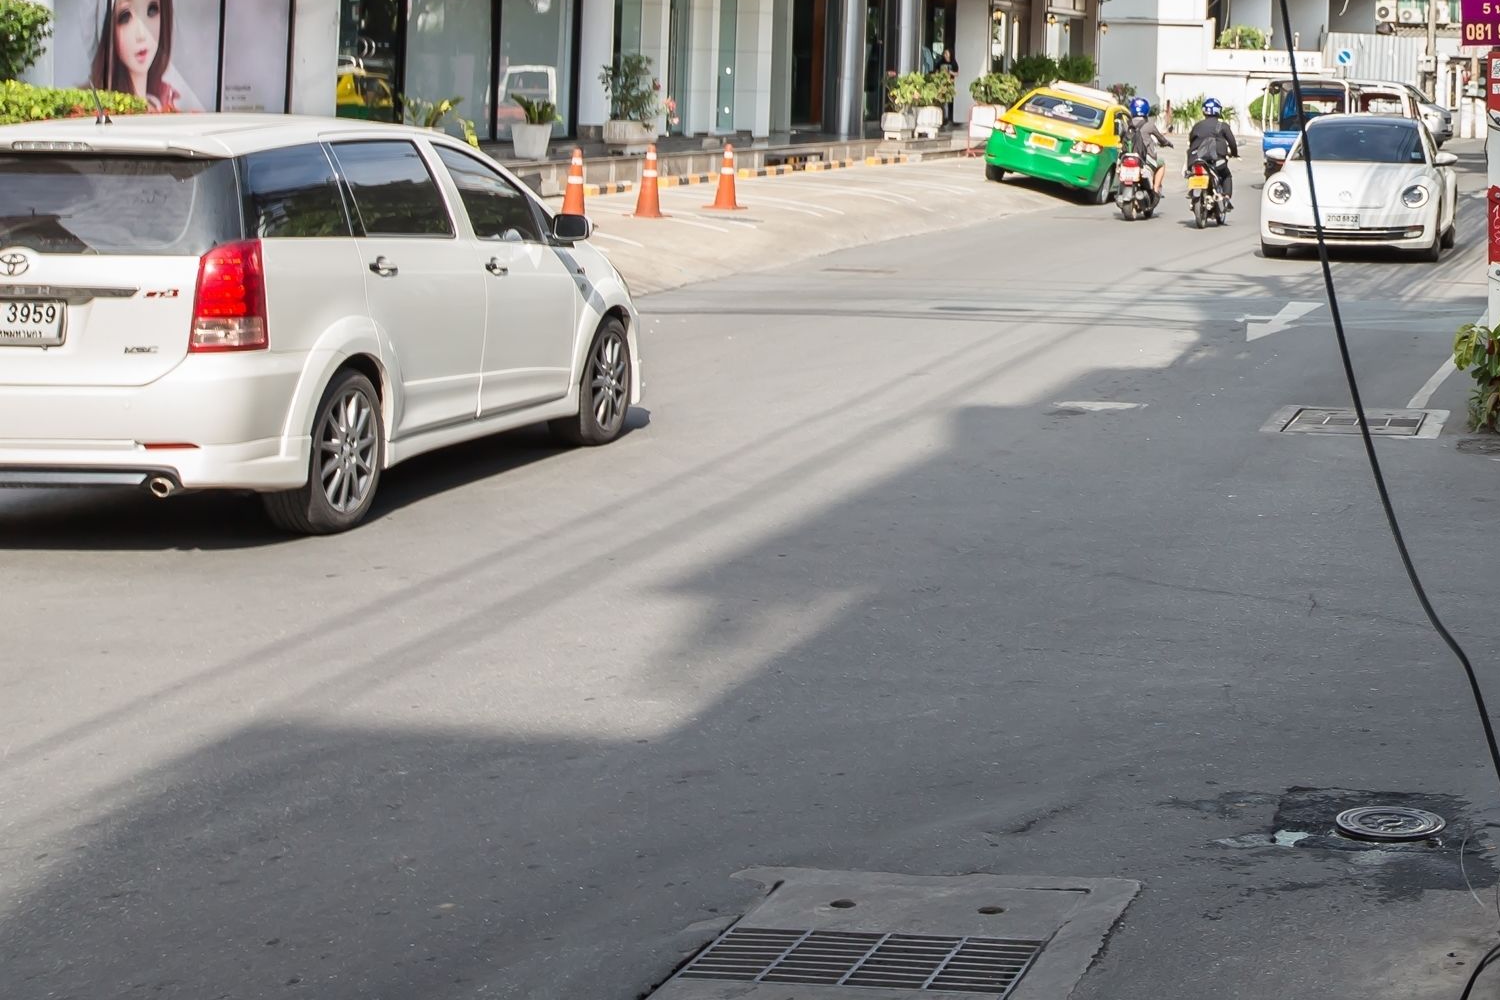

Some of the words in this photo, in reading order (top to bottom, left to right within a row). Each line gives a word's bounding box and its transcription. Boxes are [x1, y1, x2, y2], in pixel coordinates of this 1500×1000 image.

[1483, 3, 1491, 14] 5
[1466, 23, 1492, 40] 081
[7, 303, 56, 324] 3959
